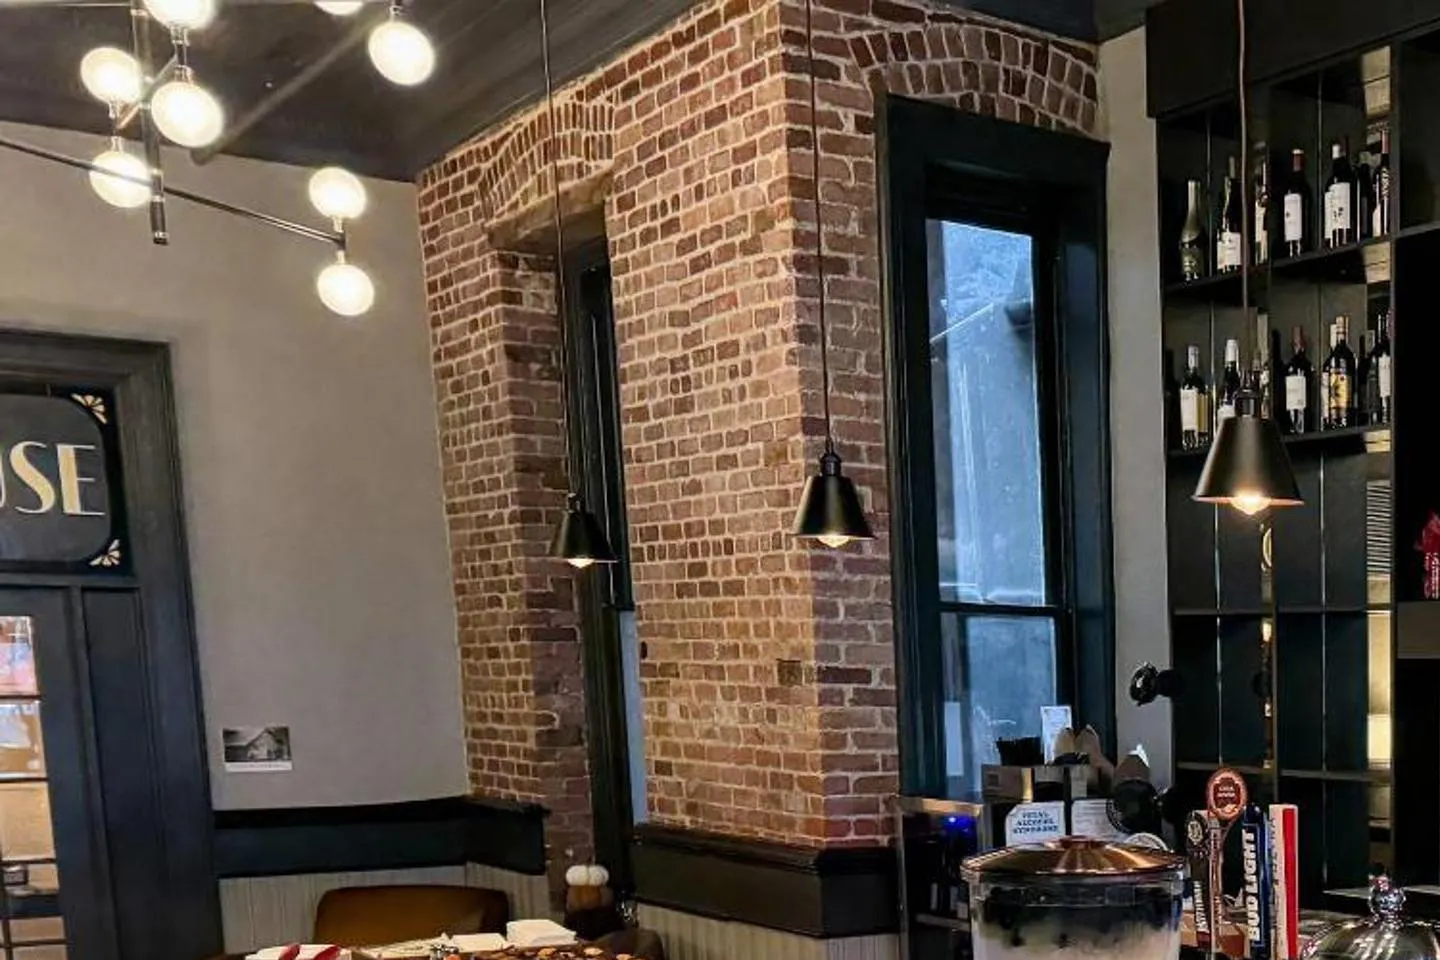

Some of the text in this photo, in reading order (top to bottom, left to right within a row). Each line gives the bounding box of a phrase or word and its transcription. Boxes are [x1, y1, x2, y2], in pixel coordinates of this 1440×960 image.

[0, 441, 105, 516] SE
[1242, 828, 1260, 942] BUD LIGHT
